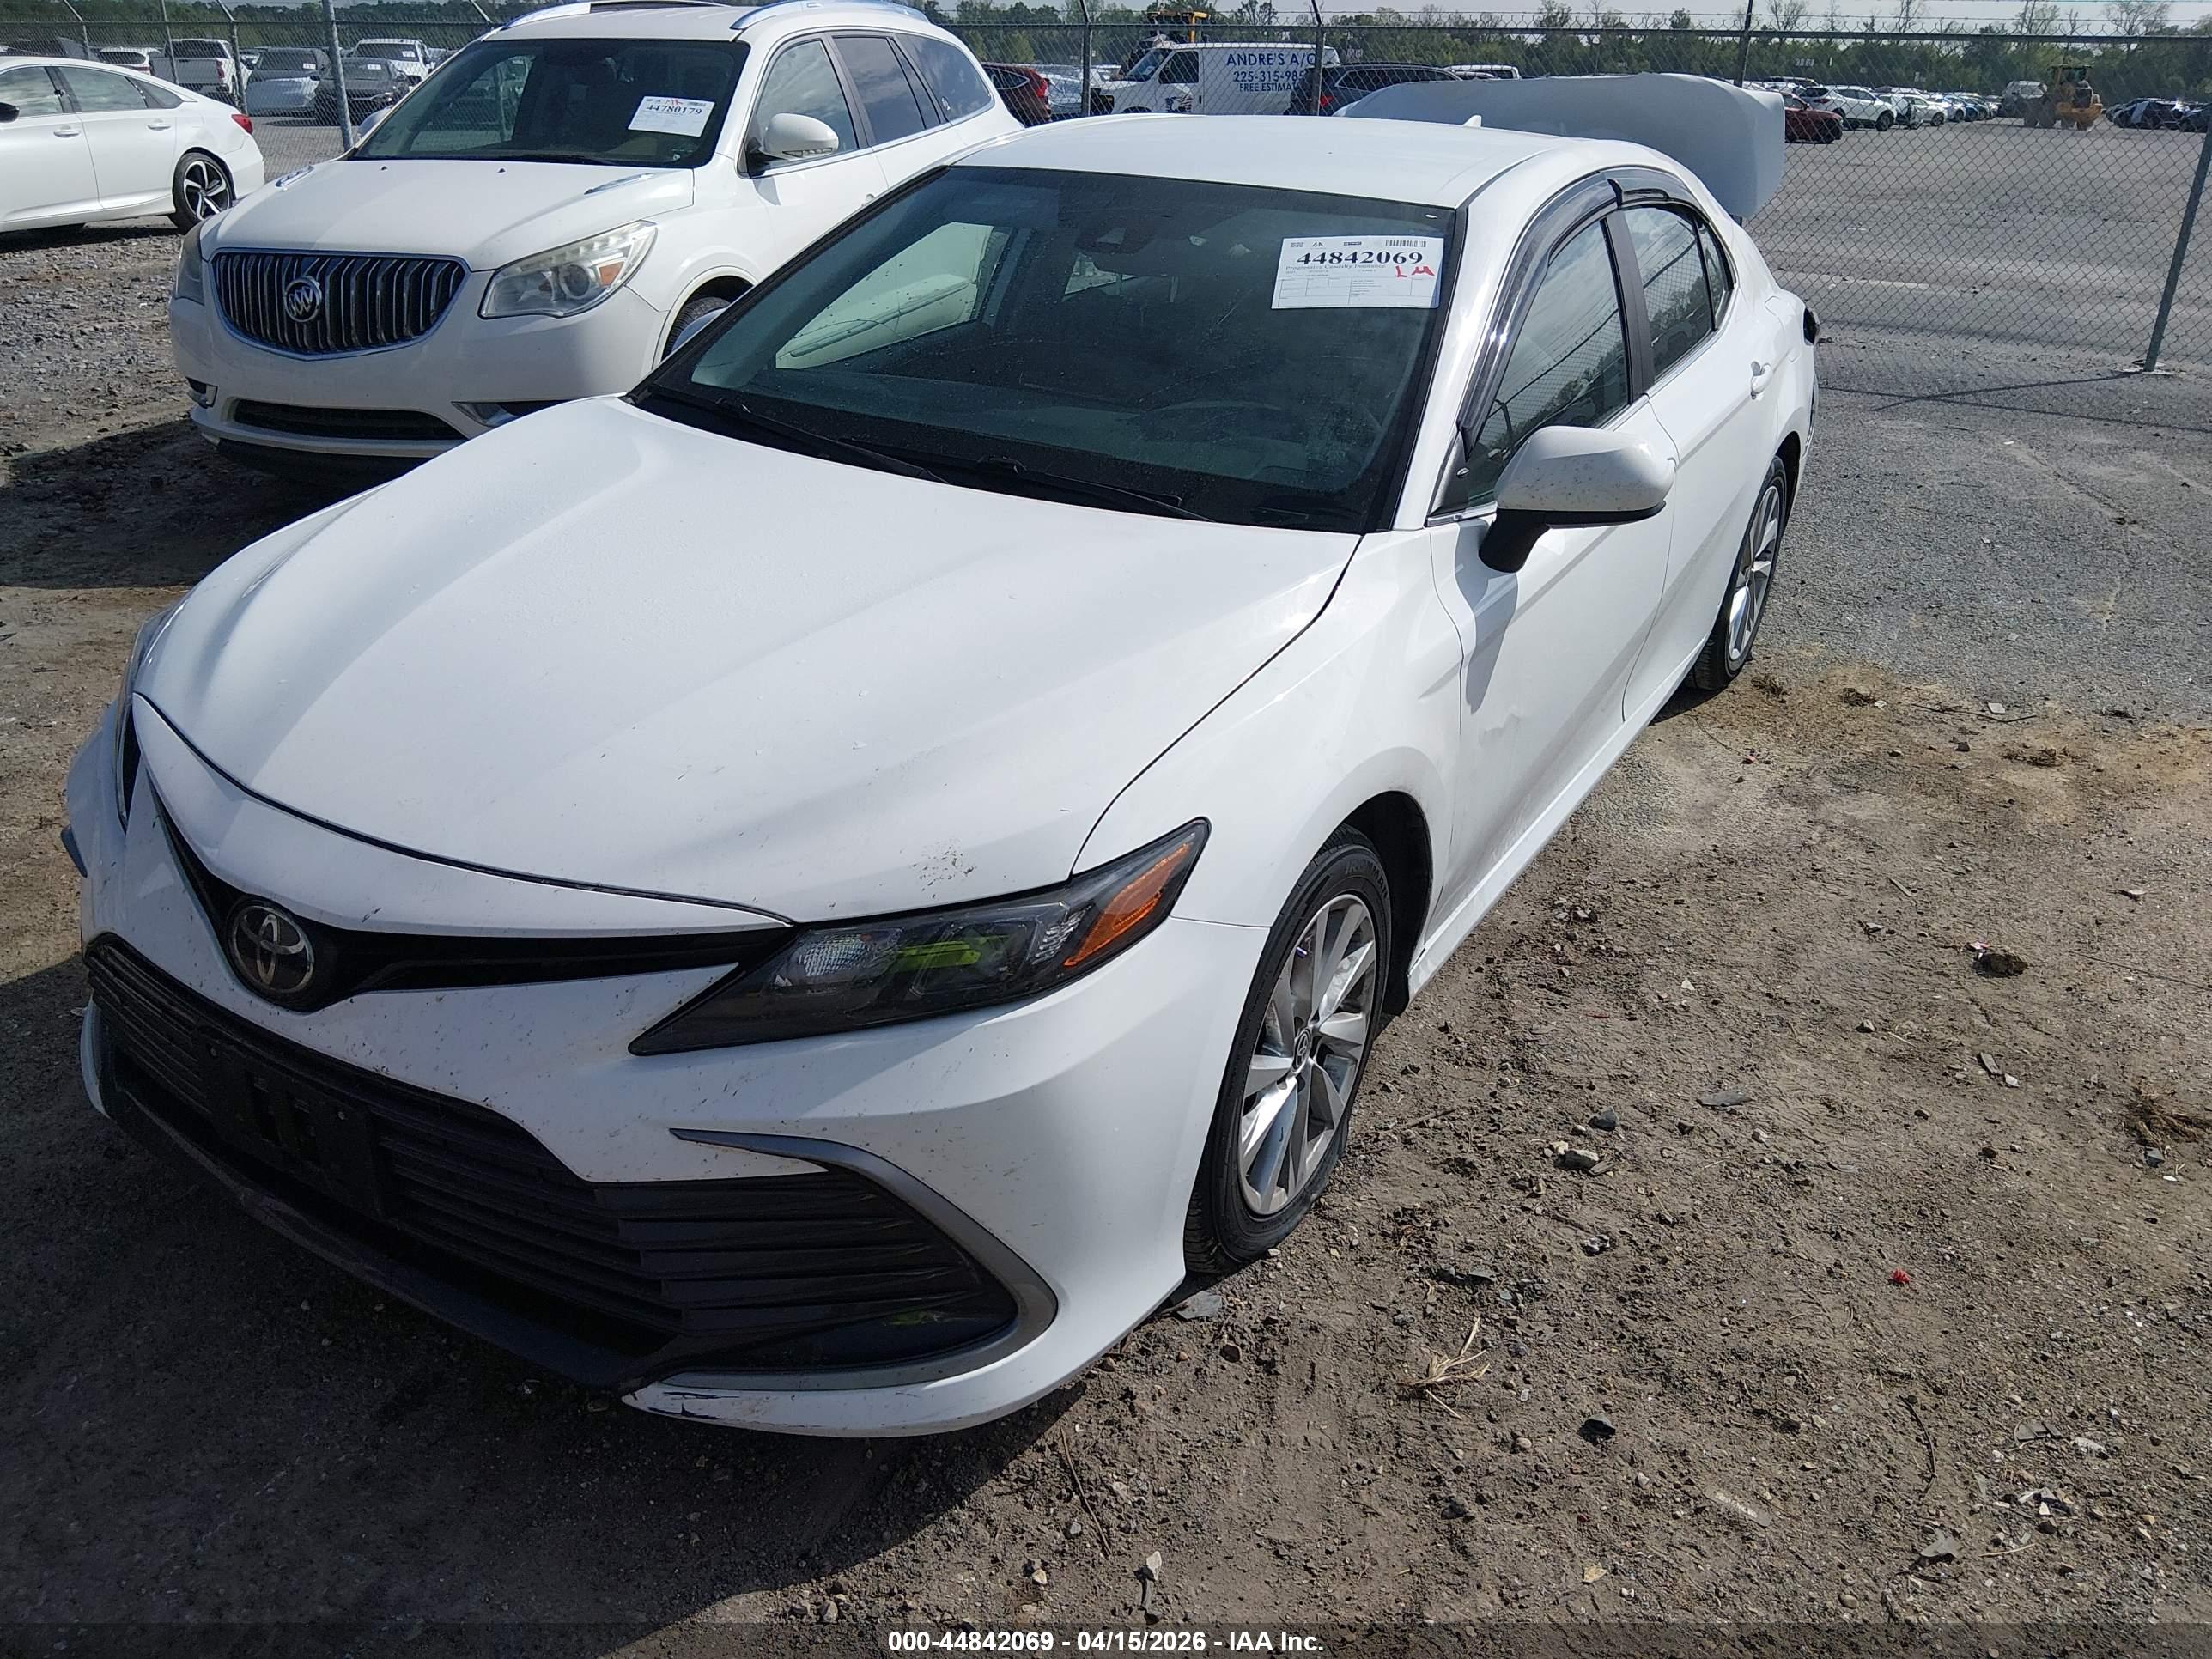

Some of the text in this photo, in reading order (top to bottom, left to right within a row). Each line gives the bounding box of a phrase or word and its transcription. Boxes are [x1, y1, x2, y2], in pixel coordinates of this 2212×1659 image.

[1226, 53, 1316, 68] ANDRE'S A/C
[1239, 83, 1260, 93] FREE
[646, 104, 702, 115] 44780179
[1297, 251, 1423, 264] 44842069
